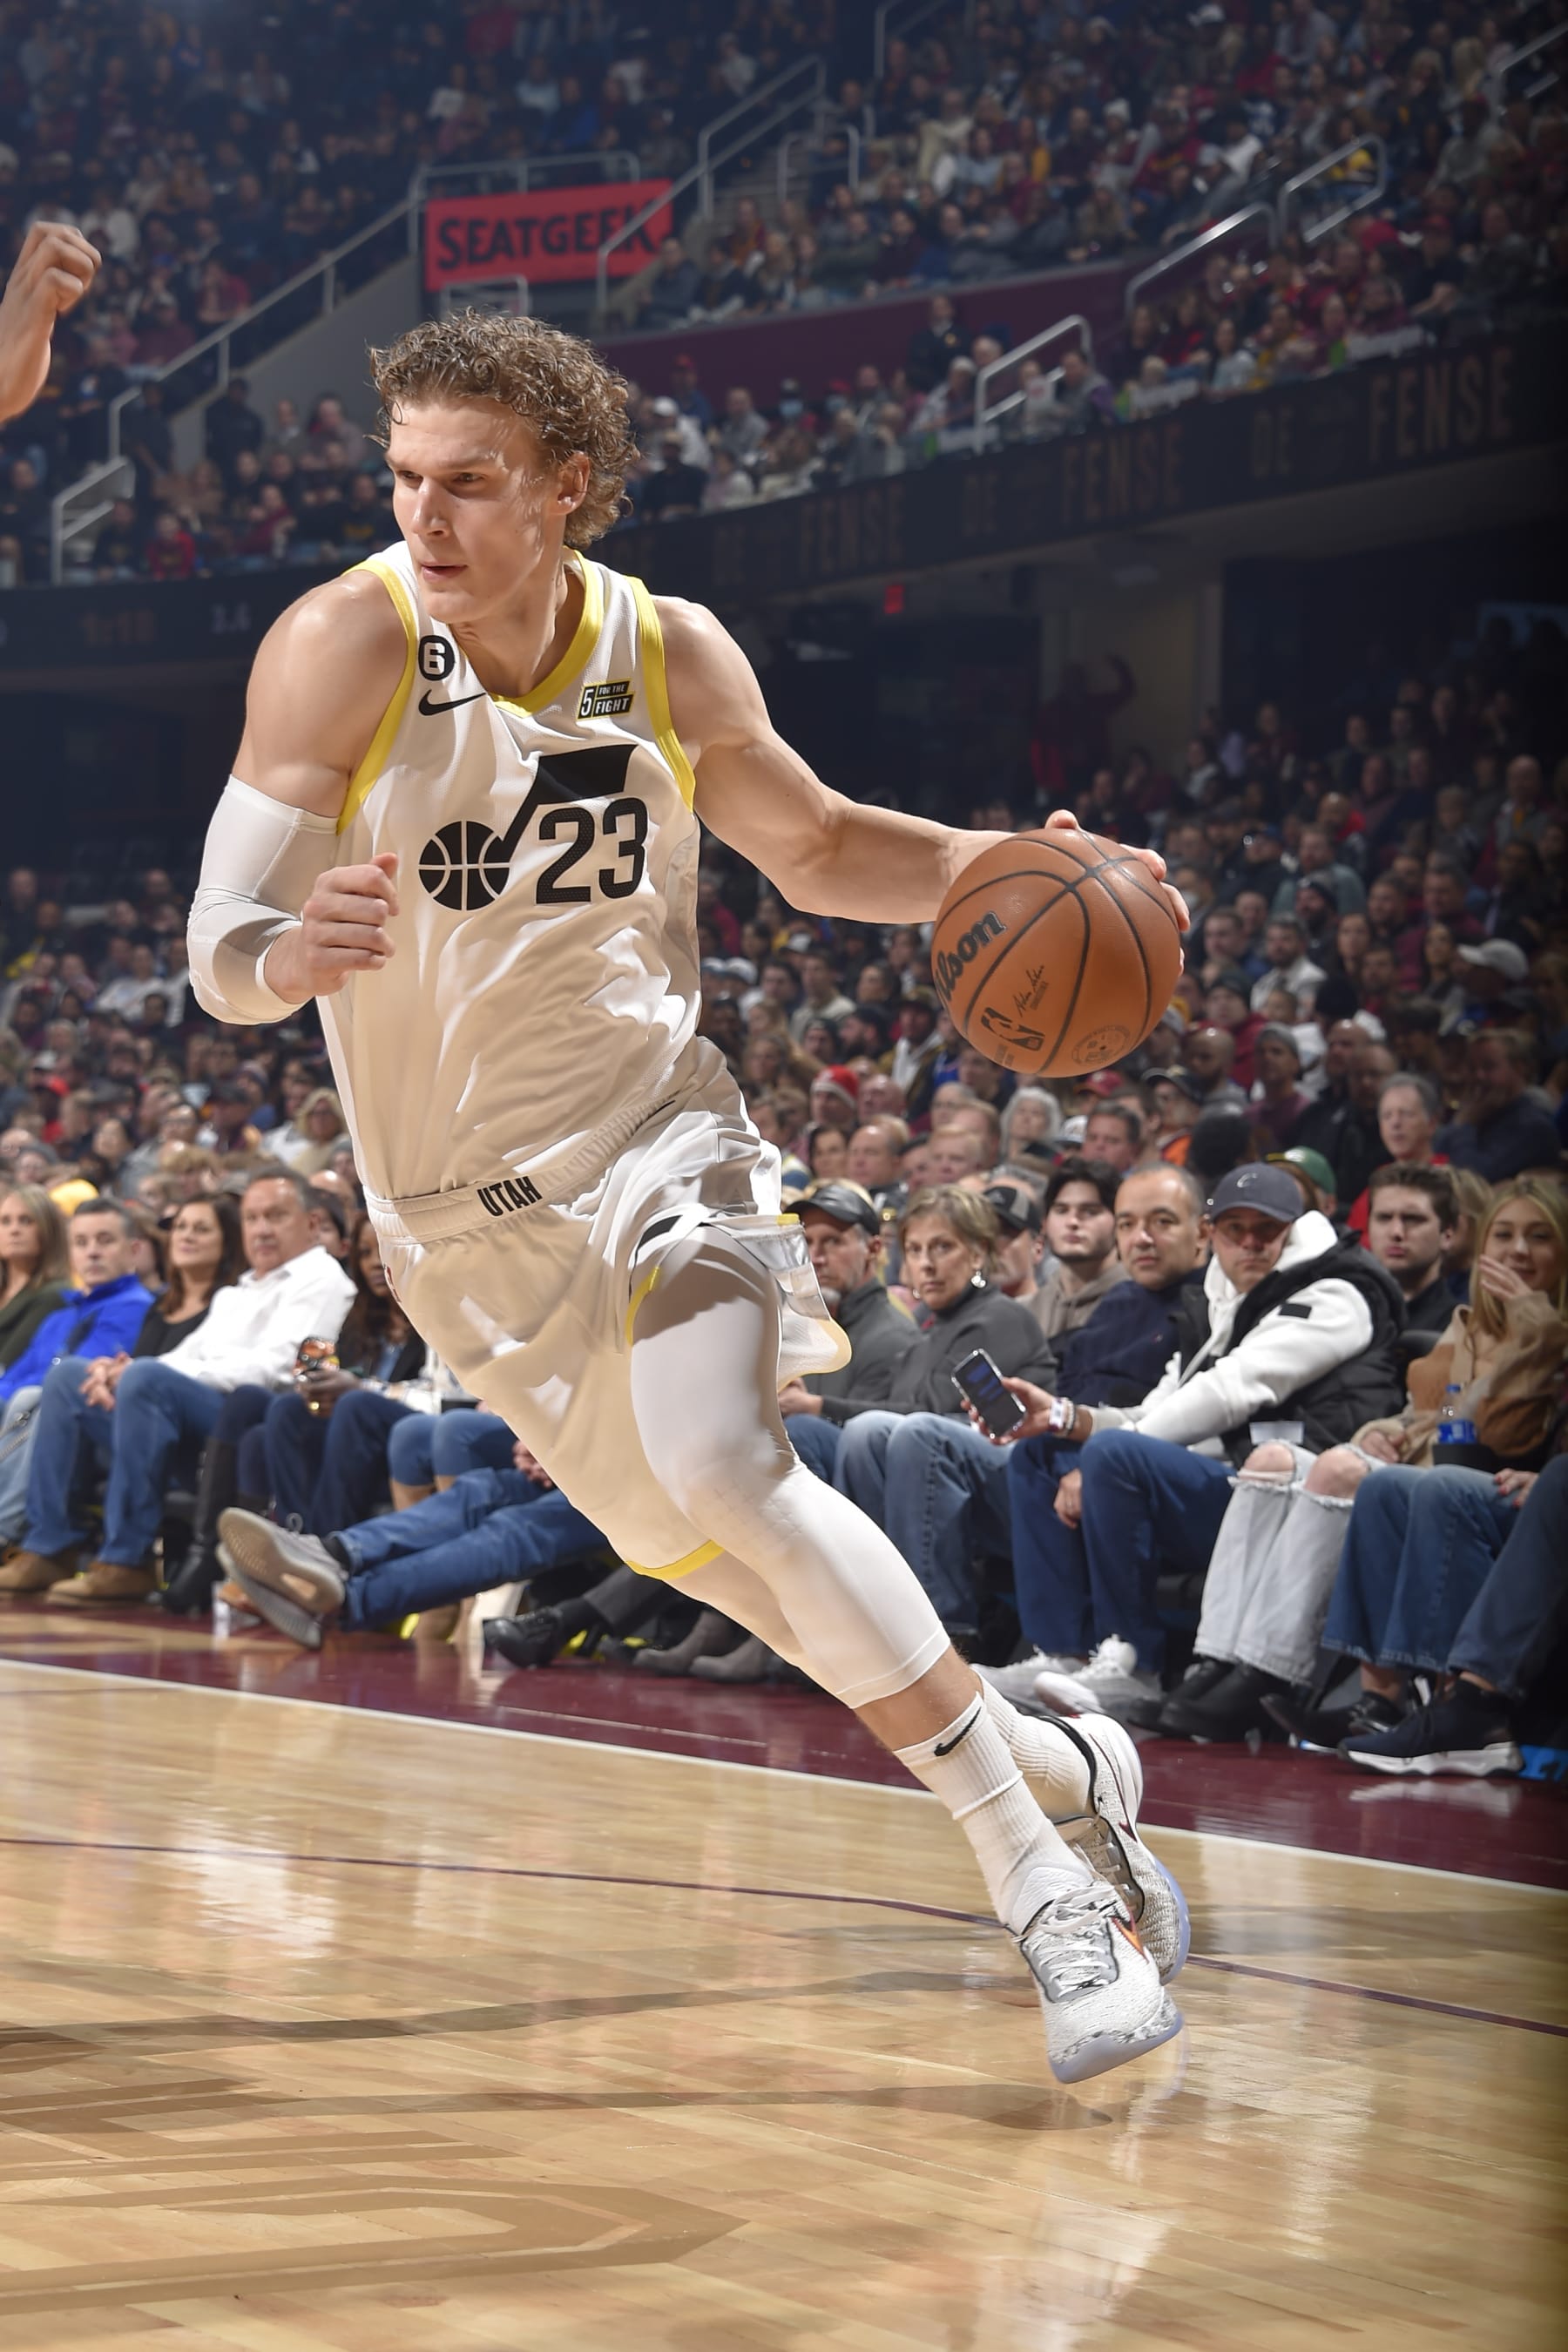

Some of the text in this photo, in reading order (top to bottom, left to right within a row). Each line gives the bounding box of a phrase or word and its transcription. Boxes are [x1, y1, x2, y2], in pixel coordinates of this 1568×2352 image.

[437, 199, 654, 270] SEATGEEK
[1369, 346, 1513, 465] FENSE
[1061, 422, 1184, 527] FENSE
[422, 641, 447, 677] 6
[580, 688, 594, 717] 5
[595, 698, 629, 714] FIGHT
[598, 684, 626, 695] FOR THE
[536, 797, 648, 904] 23
[476, 1175, 543, 1217] UTAH
